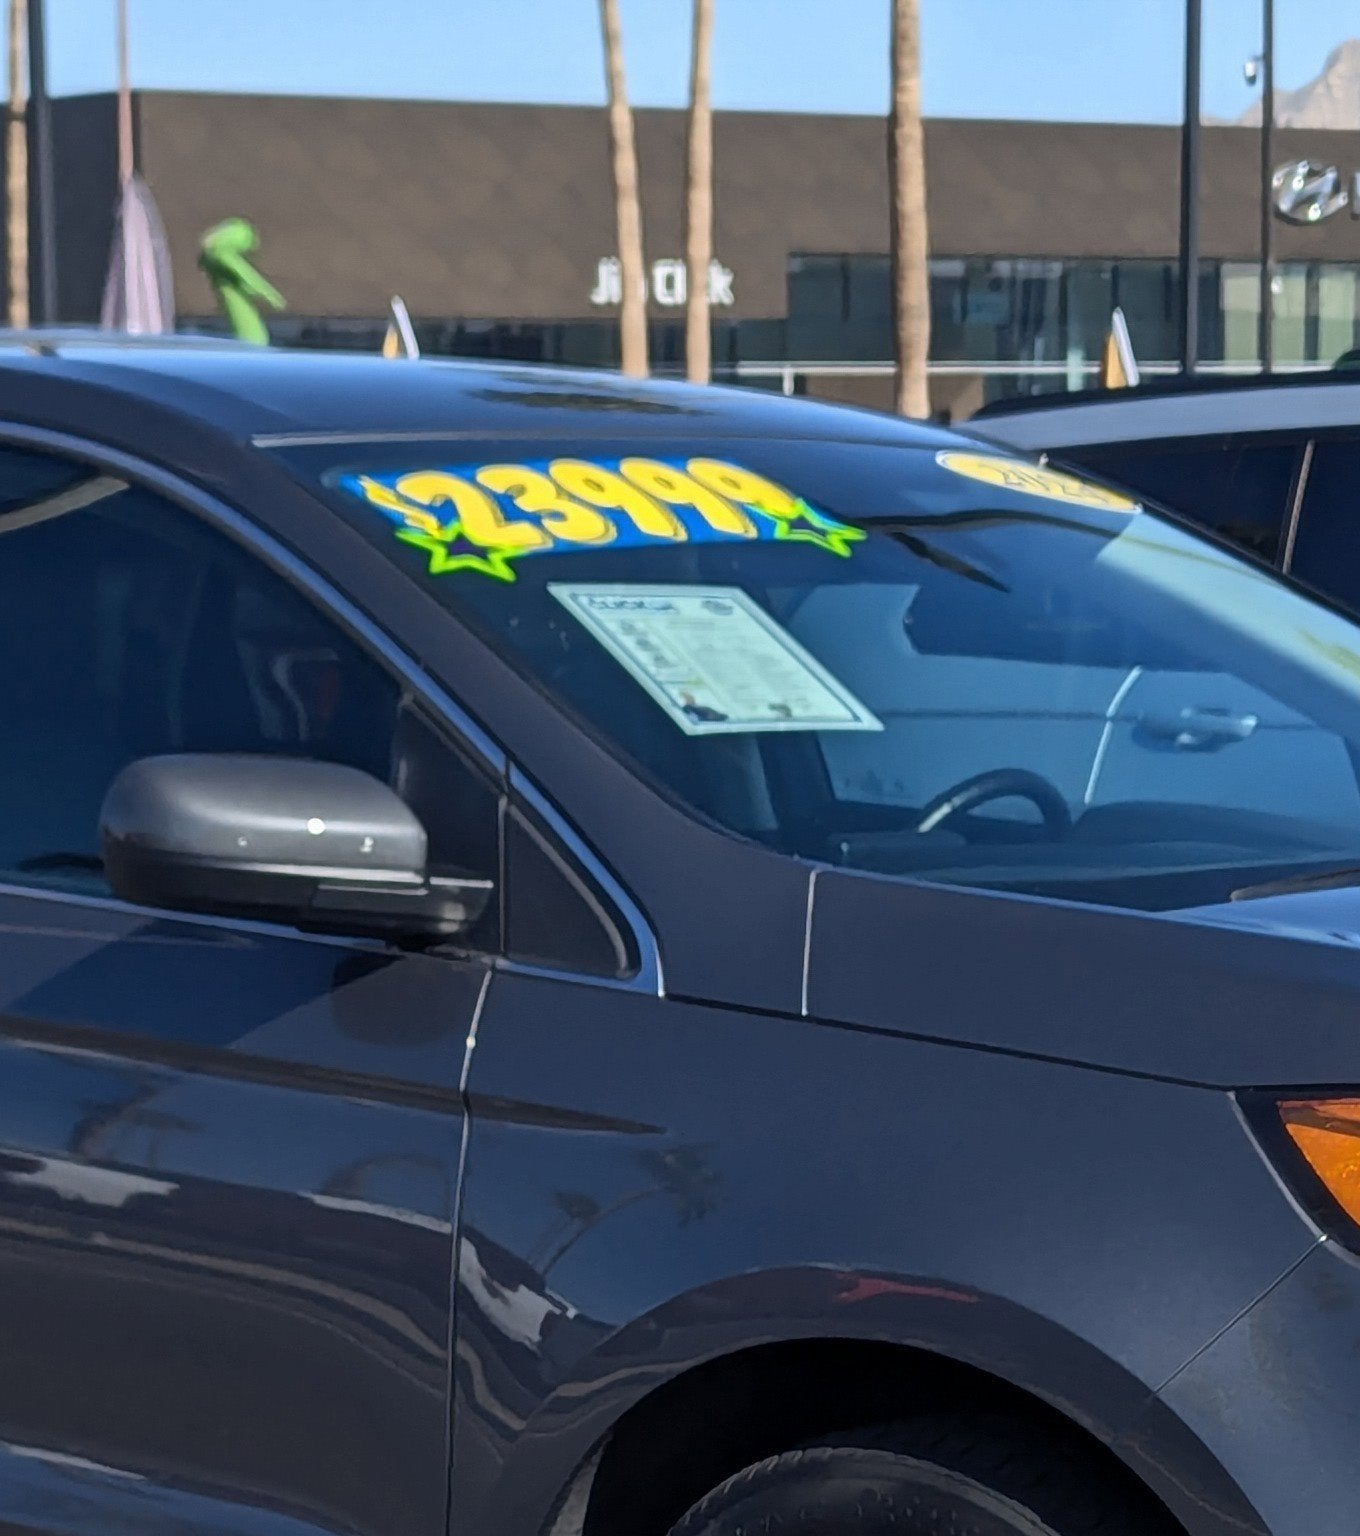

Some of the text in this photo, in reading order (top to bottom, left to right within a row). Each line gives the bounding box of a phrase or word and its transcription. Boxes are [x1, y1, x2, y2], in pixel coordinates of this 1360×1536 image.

[590, 256, 735, 305] Ji Clk
[357, 457, 798, 549] $23999
